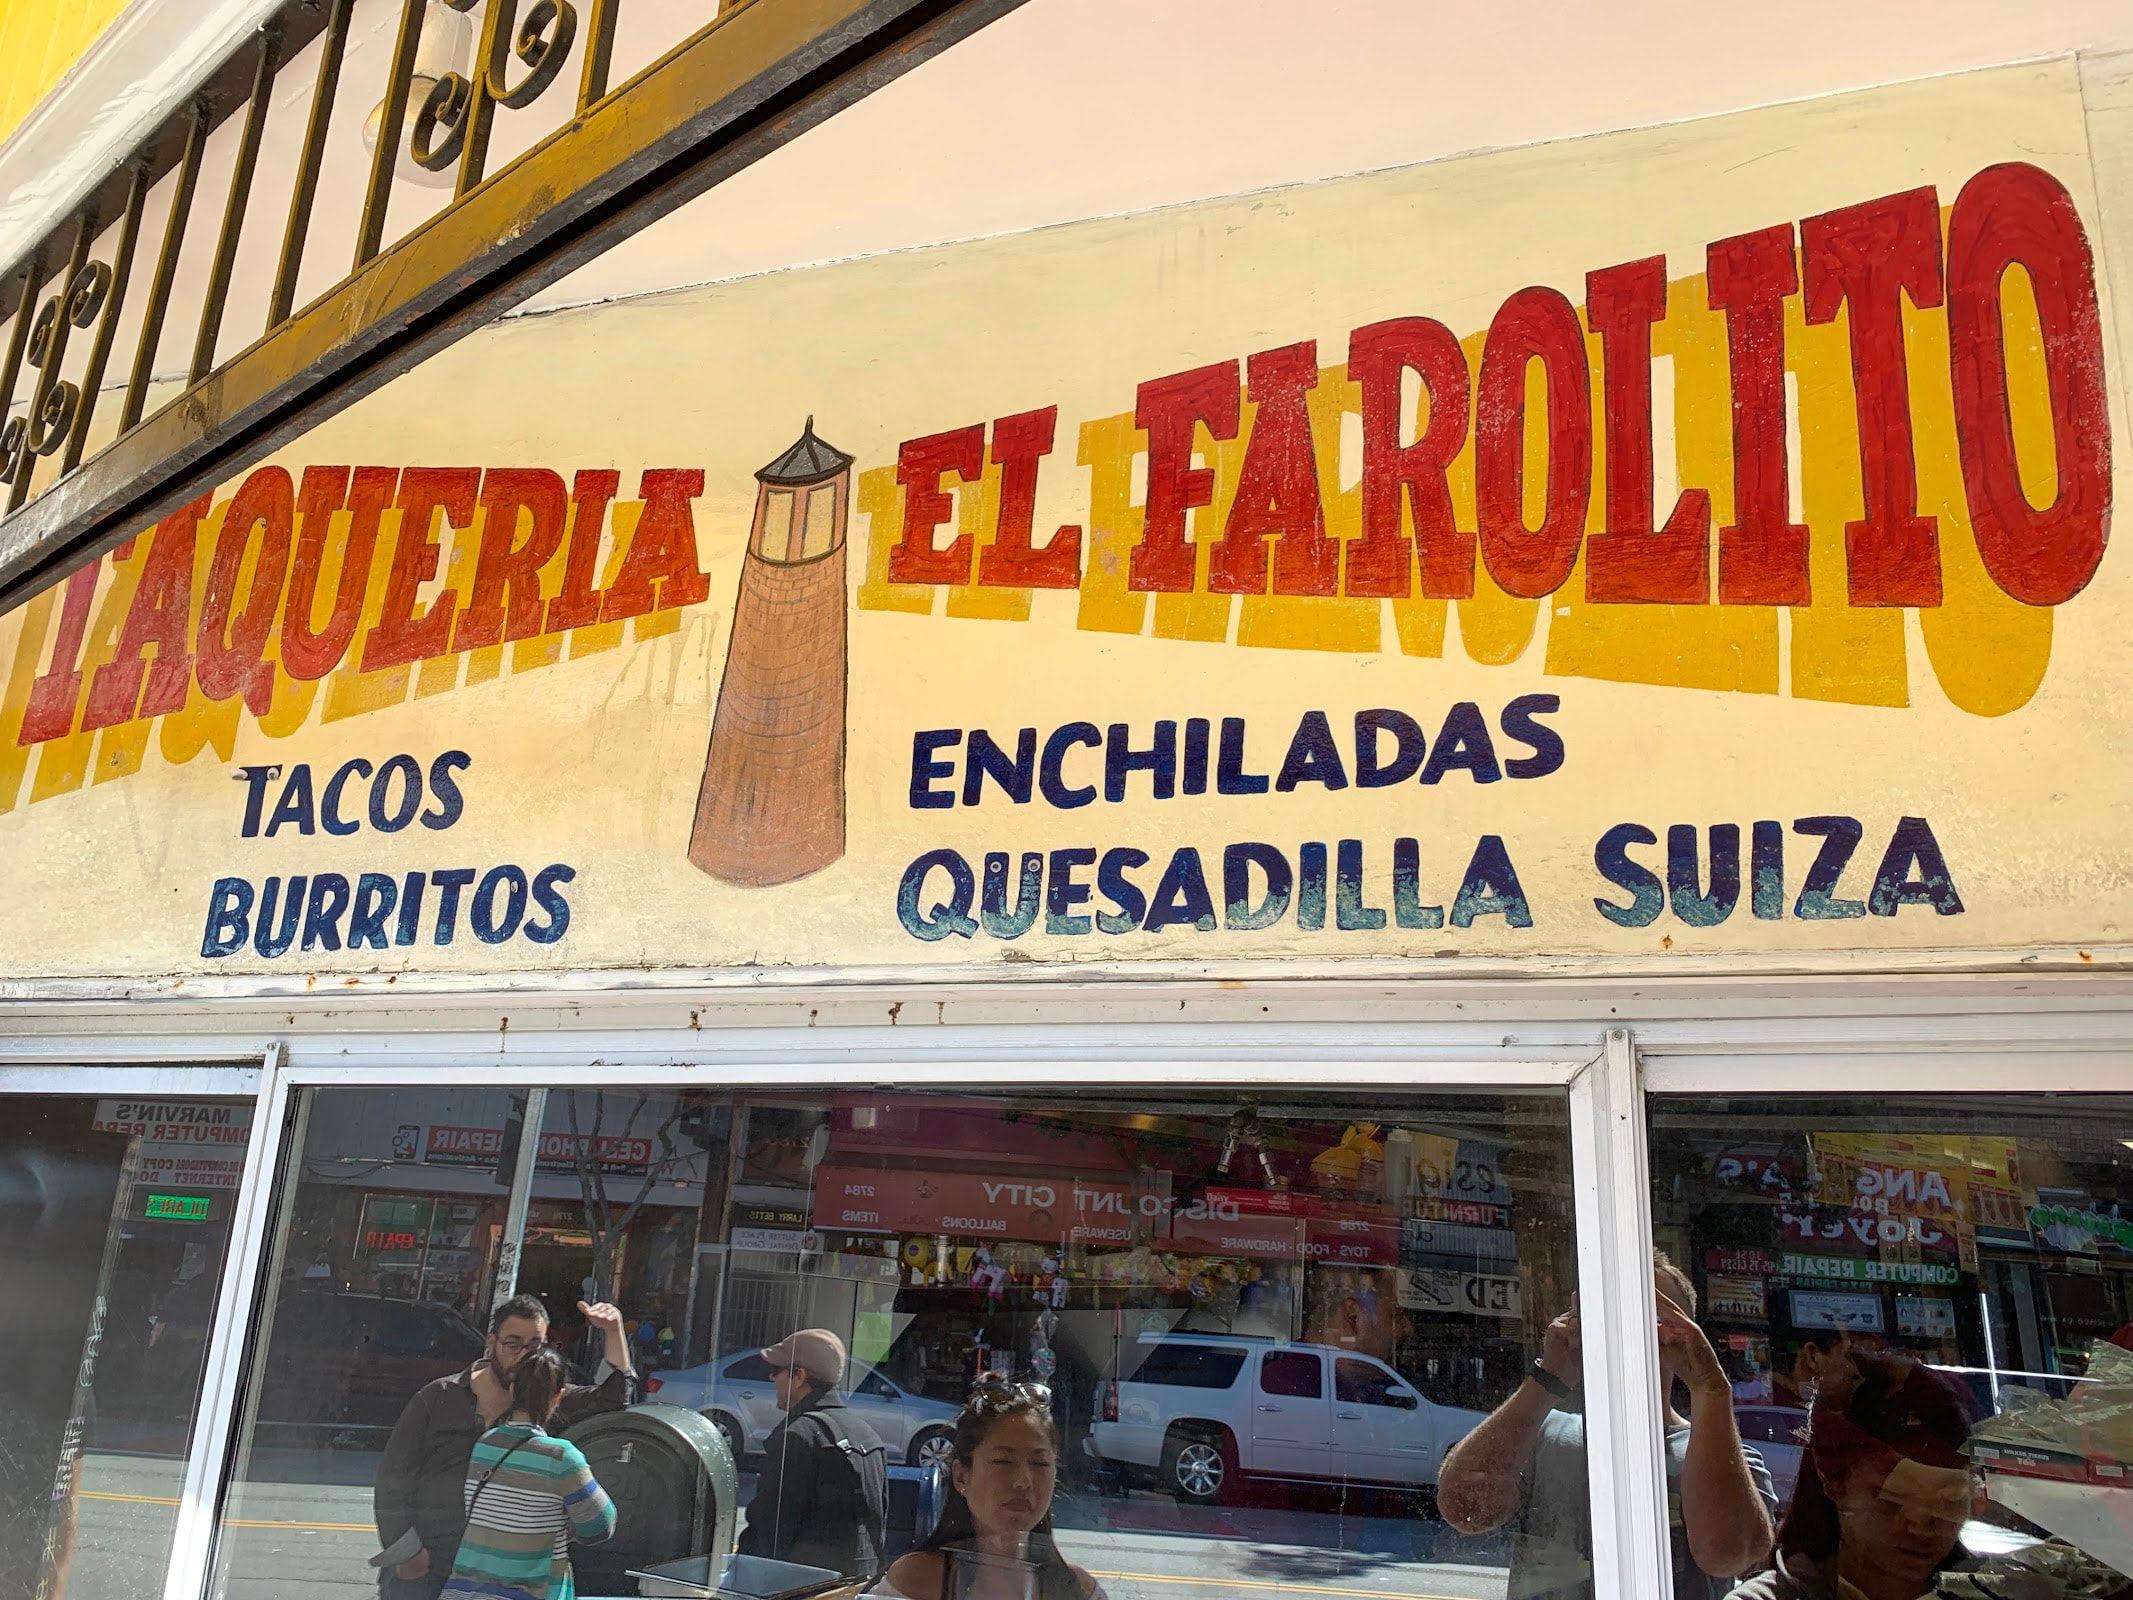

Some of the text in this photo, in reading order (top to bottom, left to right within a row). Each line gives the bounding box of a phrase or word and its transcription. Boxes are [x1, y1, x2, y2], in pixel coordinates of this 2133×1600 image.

[888, 161, 2113, 608] EL FAROLITO
[232, 750, 472, 838] TACOS
[909, 694, 1565, 809] ENCHILADAS
[199, 862, 577, 959] BURRITOS
[896, 815, 1966, 941] QUESADILLA SUIZA
